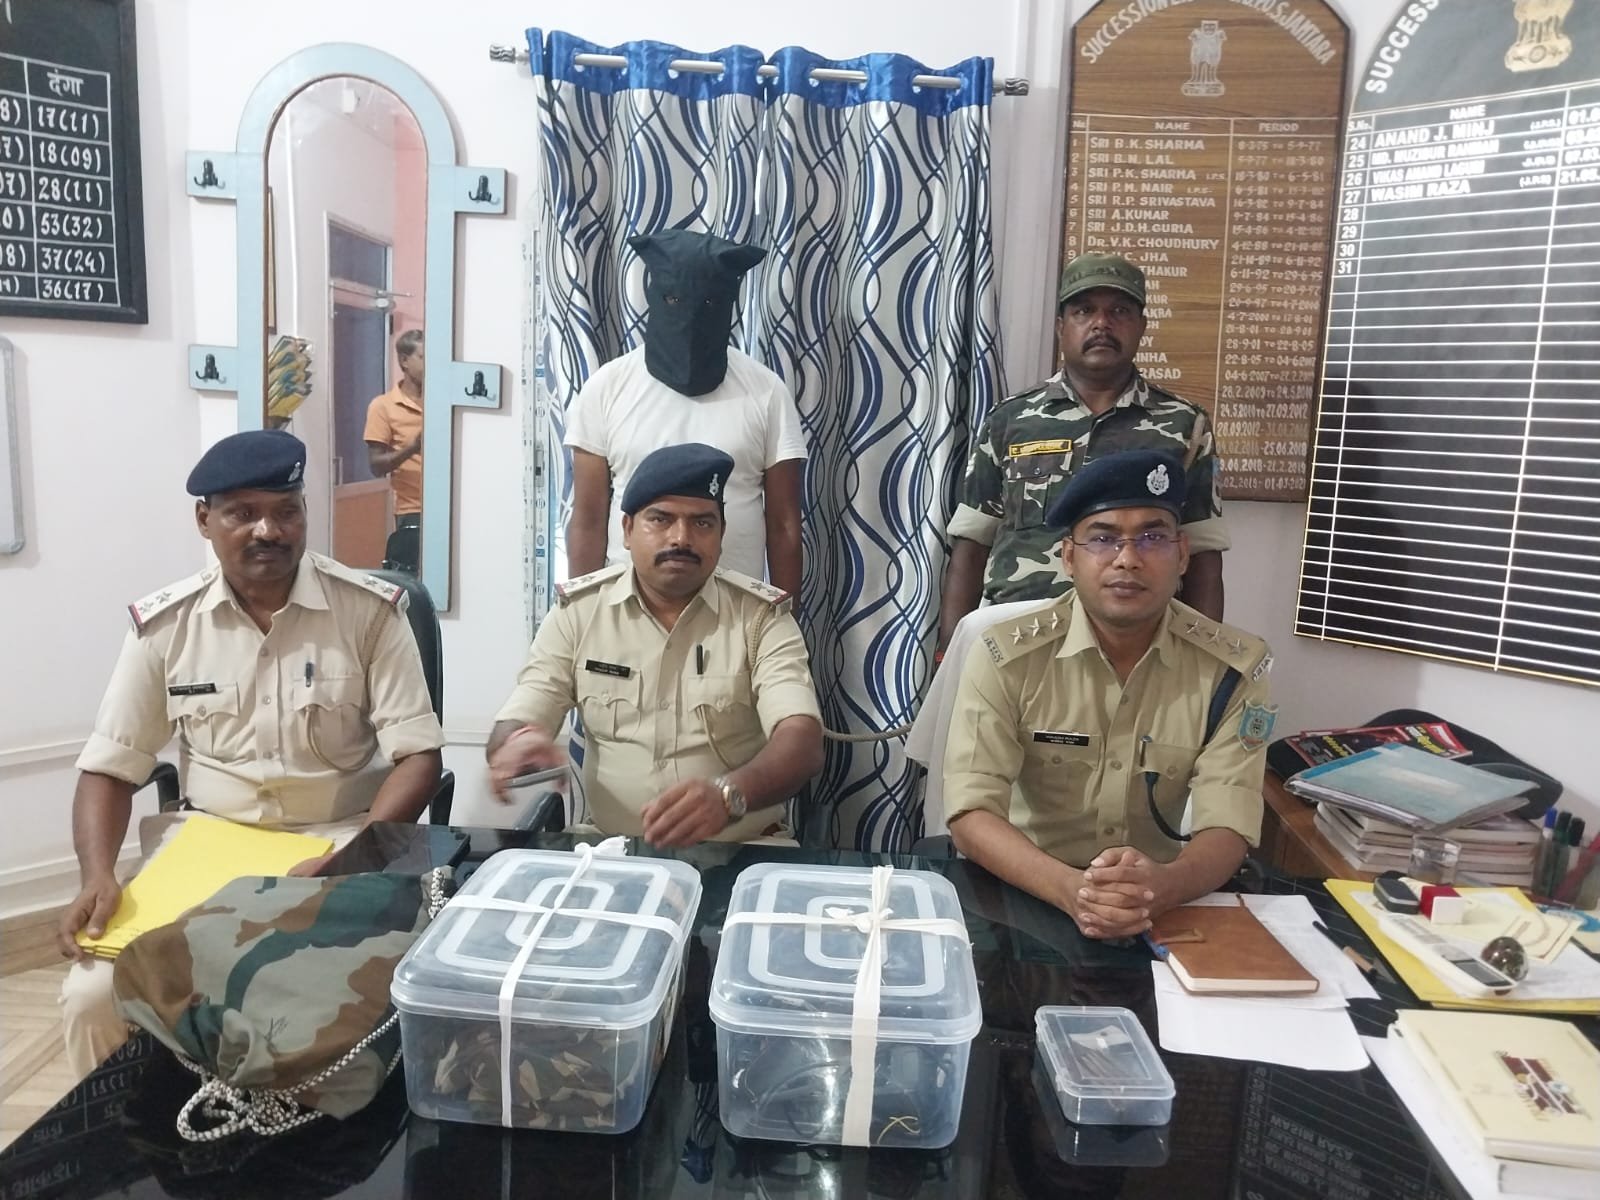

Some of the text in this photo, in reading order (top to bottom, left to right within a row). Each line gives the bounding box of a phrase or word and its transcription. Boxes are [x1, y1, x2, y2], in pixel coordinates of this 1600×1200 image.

[48, 69, 84, 96] दंगा
[1449, 104, 1486, 120] NAME
[37, 105, 99, 138] 17(11)
[1154, 121, 1191, 131] NAME
[1258, 122, 1300, 132] PERIOD
[1350, 136, 1366, 151] 24
[1374, 127, 1430, 148] ANAND
[1452, 119, 1495, 139] MINJ
[1090, 137, 1109, 149] SRI
[1145, 139, 1205, 151] SHARMA
[39, 141, 101, 173] 18(09)
[1071, 153, 1079, 163] 2
[1089, 152, 1109, 164] SRI
[1145, 154, 1175, 165] LAL
[1348, 154, 1365, 168] 25
[1071, 167, 1078, 177] 3
[1088, 167, 1108, 178] SRI
[1140, 169, 1196, 180] SHARMA
[1346, 172, 1363, 186] 26
[38, 177, 103, 206] 28(11)
[1070, 182, 1078, 191] 4
[1088, 181, 1108, 192] SRI
[1140, 182, 1174, 193] NAIR
[1344, 190, 1361, 204] 27
[1371, 183, 1424, 202] WASIM
[1426, 179, 1471, 198] RAZA
[1070, 195, 1079, 204] 5
[1087, 194, 1106, 205] SRI
[1139, 196, 1216, 207] SRIVASTAVA
[1069, 208, 1078, 217] 6
[1087, 208, 1106, 219] SRI
[1343, 207, 1359, 222] 28
[41, 213, 103, 238] 53(32)
[1069, 222, 1077, 231] 7
[1087, 221, 1105, 233] SRI
[1341, 225, 1357, 240] 29
[1068, 236, 1077, 247] 8
[1067, 251, 1077, 260] 9
[1140, 252, 1169, 262] JHA
[1339, 243, 1355, 258] 30
[41, 247, 106, 274] 37(24)
[1338, 261, 1353, 275] 31
[42, 280, 104, 302] 36(17)
[1145, 280, 1160, 290] AH
[1145, 294, 1169, 305] KUR
[1142, 308, 1172, 319] AKRA
[1135, 353, 1168, 364] INHA
[1140, 367, 1182, 380] RASAD
